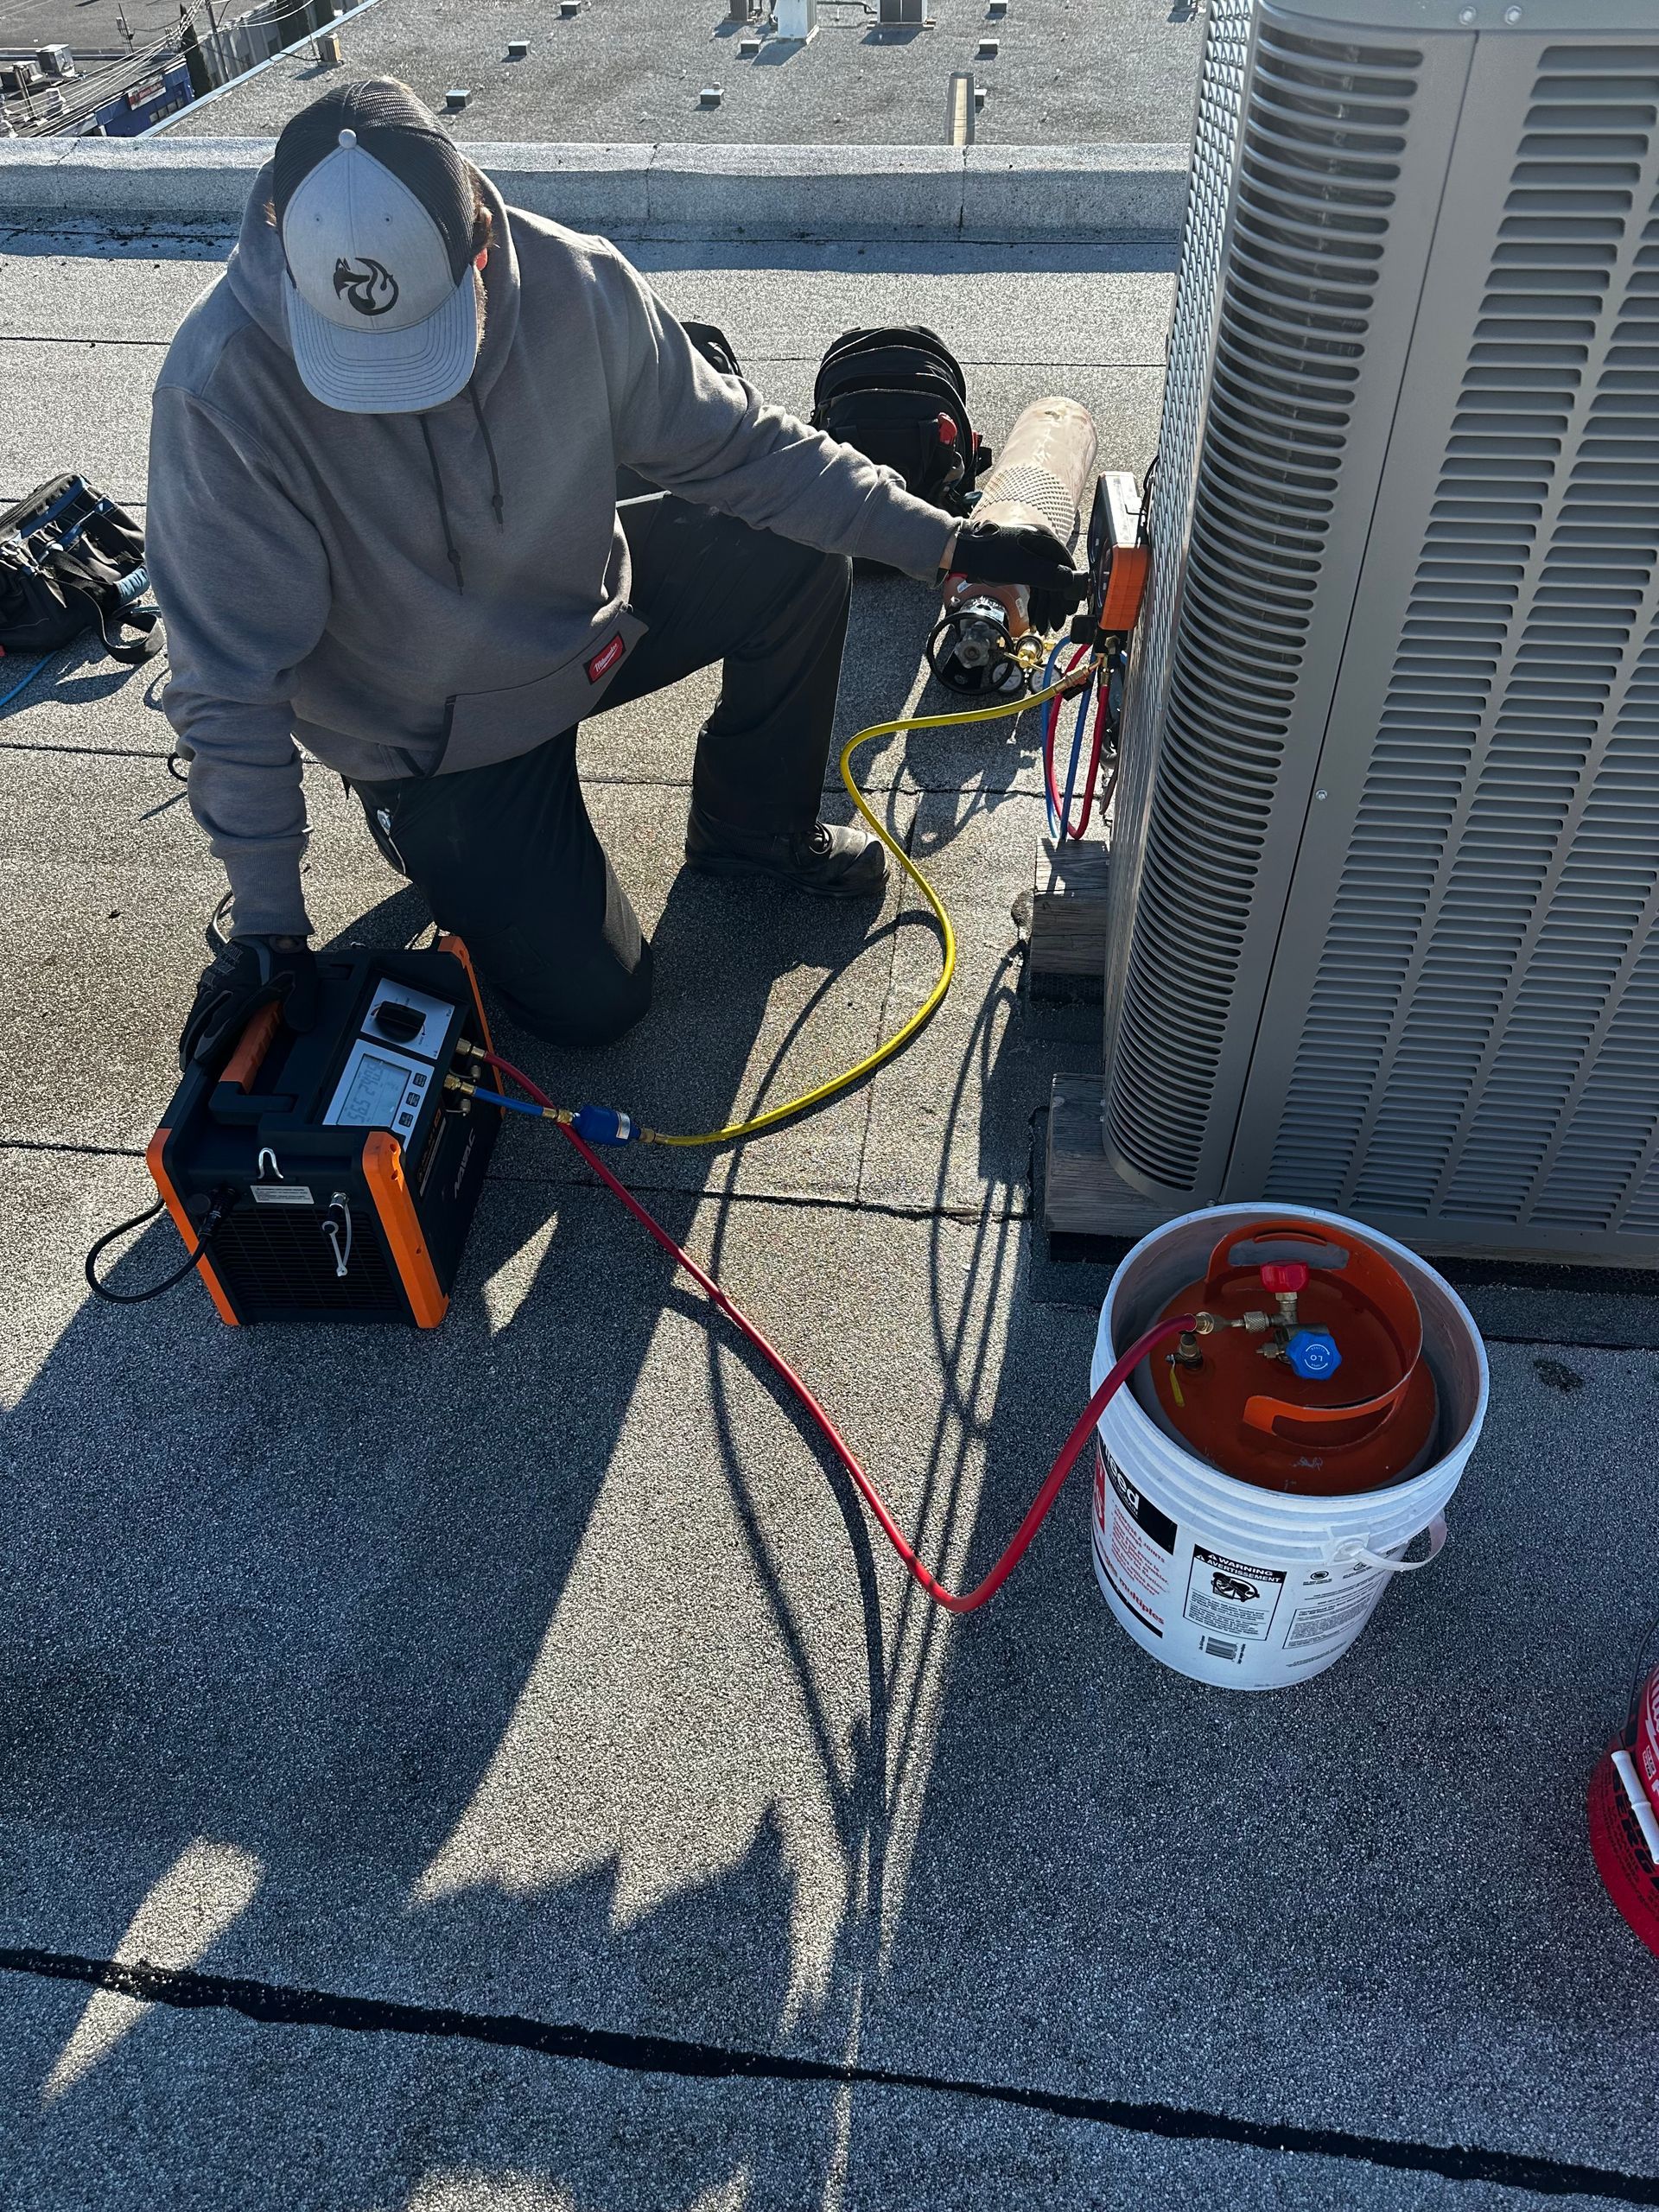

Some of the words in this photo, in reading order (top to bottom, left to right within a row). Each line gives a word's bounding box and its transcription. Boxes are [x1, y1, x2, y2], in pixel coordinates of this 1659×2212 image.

[1206, 1559, 1281, 1583] AVERTISSEMENT
[1218, 1557, 1274, 1576] WARNING
[1119, 1575, 1165, 1625] multiples
